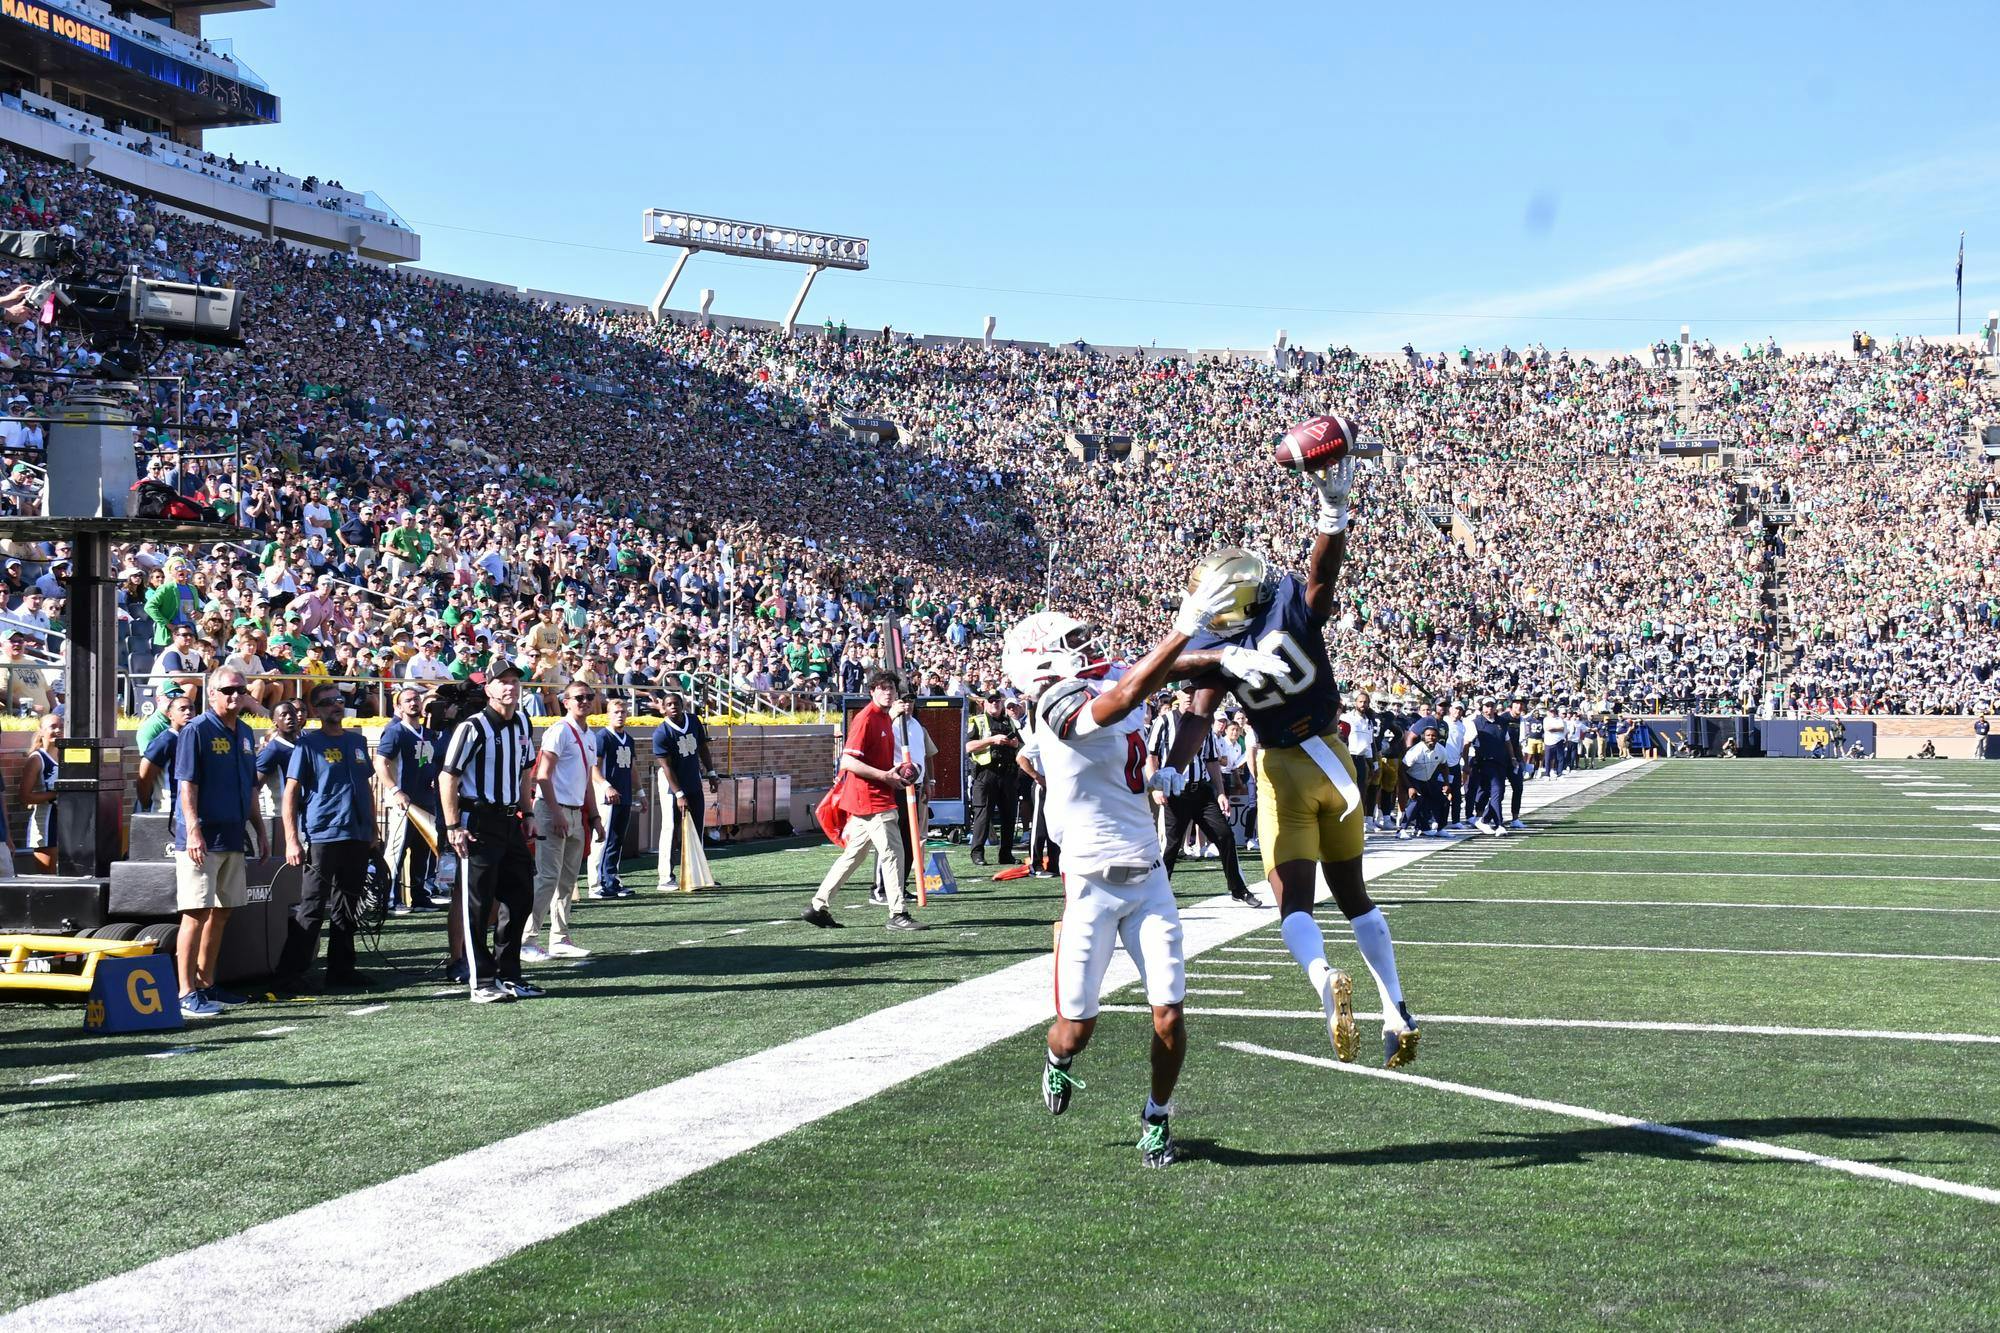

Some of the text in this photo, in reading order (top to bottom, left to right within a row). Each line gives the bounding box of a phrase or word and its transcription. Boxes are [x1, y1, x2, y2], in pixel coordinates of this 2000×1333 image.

[1, 0, 110, 51] MAKE NOISE!!
[853, 669, 860, 680] 7
[495, 736, 502, 745] S
[126, 969, 163, 1015] G
